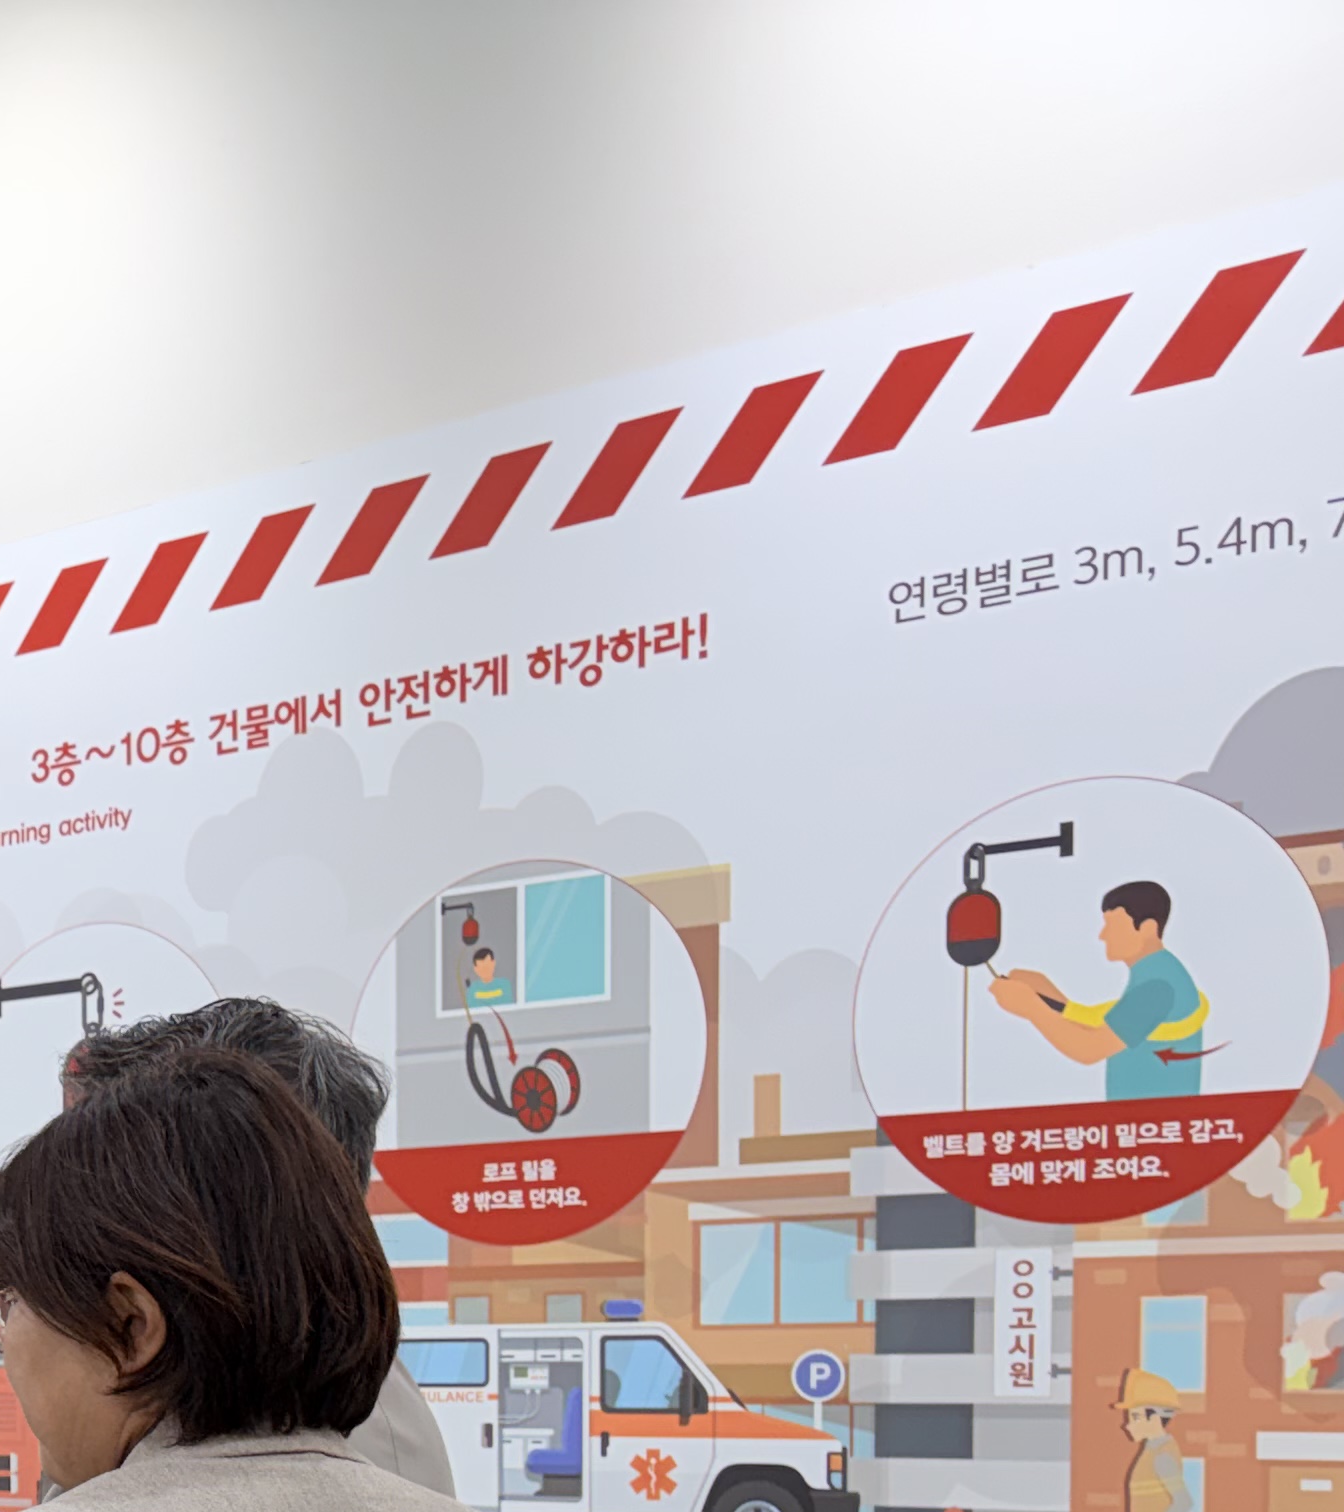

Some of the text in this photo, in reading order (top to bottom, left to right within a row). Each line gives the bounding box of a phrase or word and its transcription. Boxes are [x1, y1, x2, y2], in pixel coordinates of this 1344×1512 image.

[889, 554, 1059, 623] 연령별로
[1074, 547, 1154, 584] 3m,
[1175, 517, 1306, 565] 5.4m,
[210, 690, 341, 755] 건물에서
[359, 655, 508, 727] 안전하게
[528, 614, 707, 686] 하강하라!
[58, 807, 132, 837] activity
[924, 1119, 1243, 1158] 벨트를 양 겨드랑이 밑으로 감고,
[483, 1163, 517, 1182] 로프
[990, 1156, 1169, 1186] 몸에 맞게 조여요.
[452, 1187, 586, 1213] 창 밖으로 던져요.
[810, 1362, 832, 1390] P
